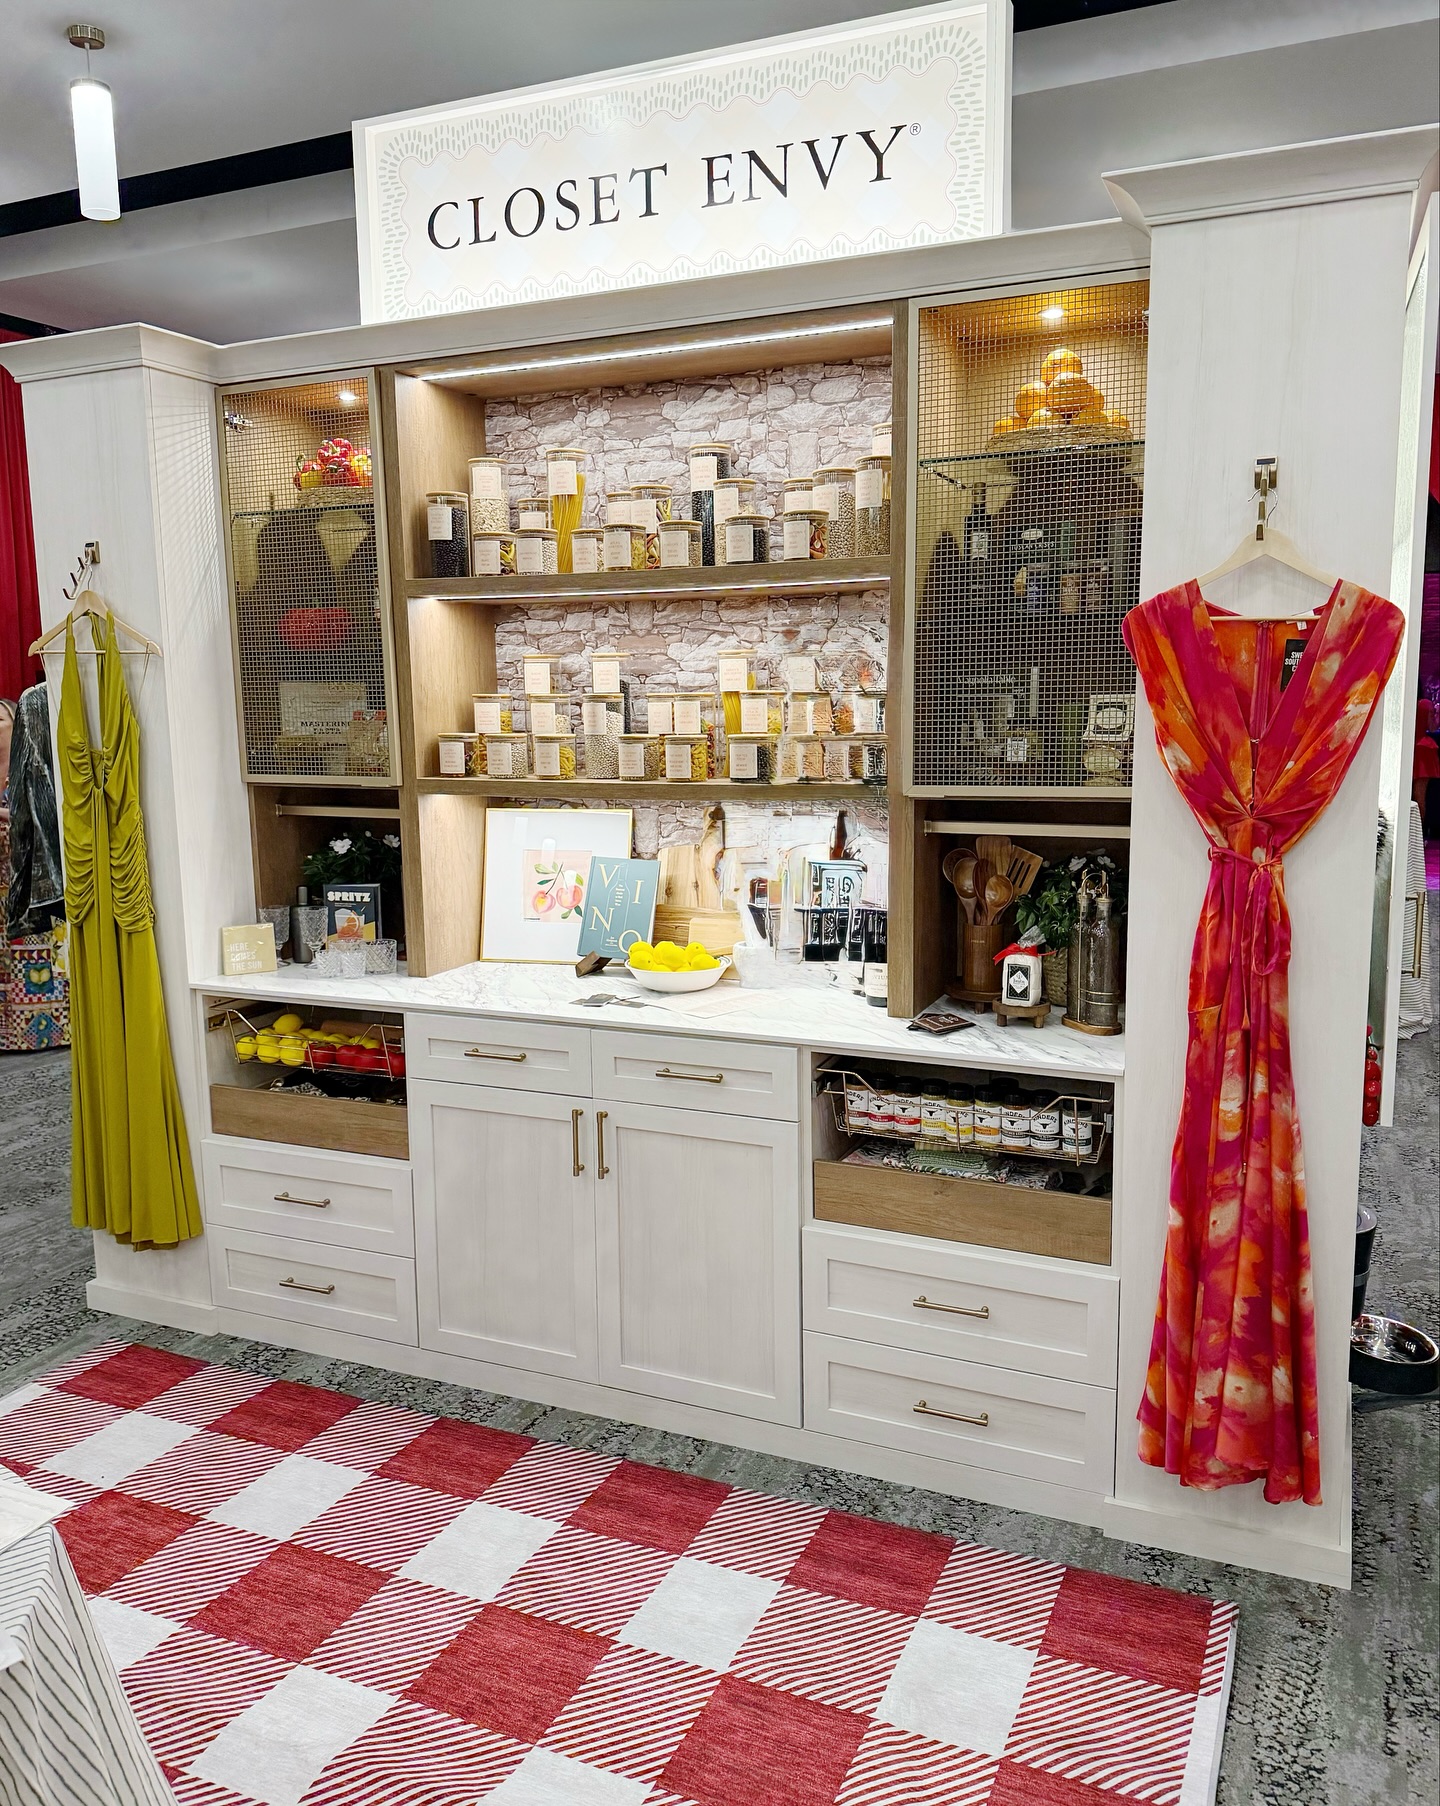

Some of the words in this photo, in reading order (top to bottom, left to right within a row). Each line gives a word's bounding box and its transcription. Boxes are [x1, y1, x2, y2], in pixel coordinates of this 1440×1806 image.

[426, 162, 669, 251] CLOSET
[327, 891, 371, 902] SPRITZ
[230, 942, 250, 952] HERE
[231, 951, 256, 962] COMES
[232, 961, 247, 971] THE
[247, 960, 263, 970] SUN
